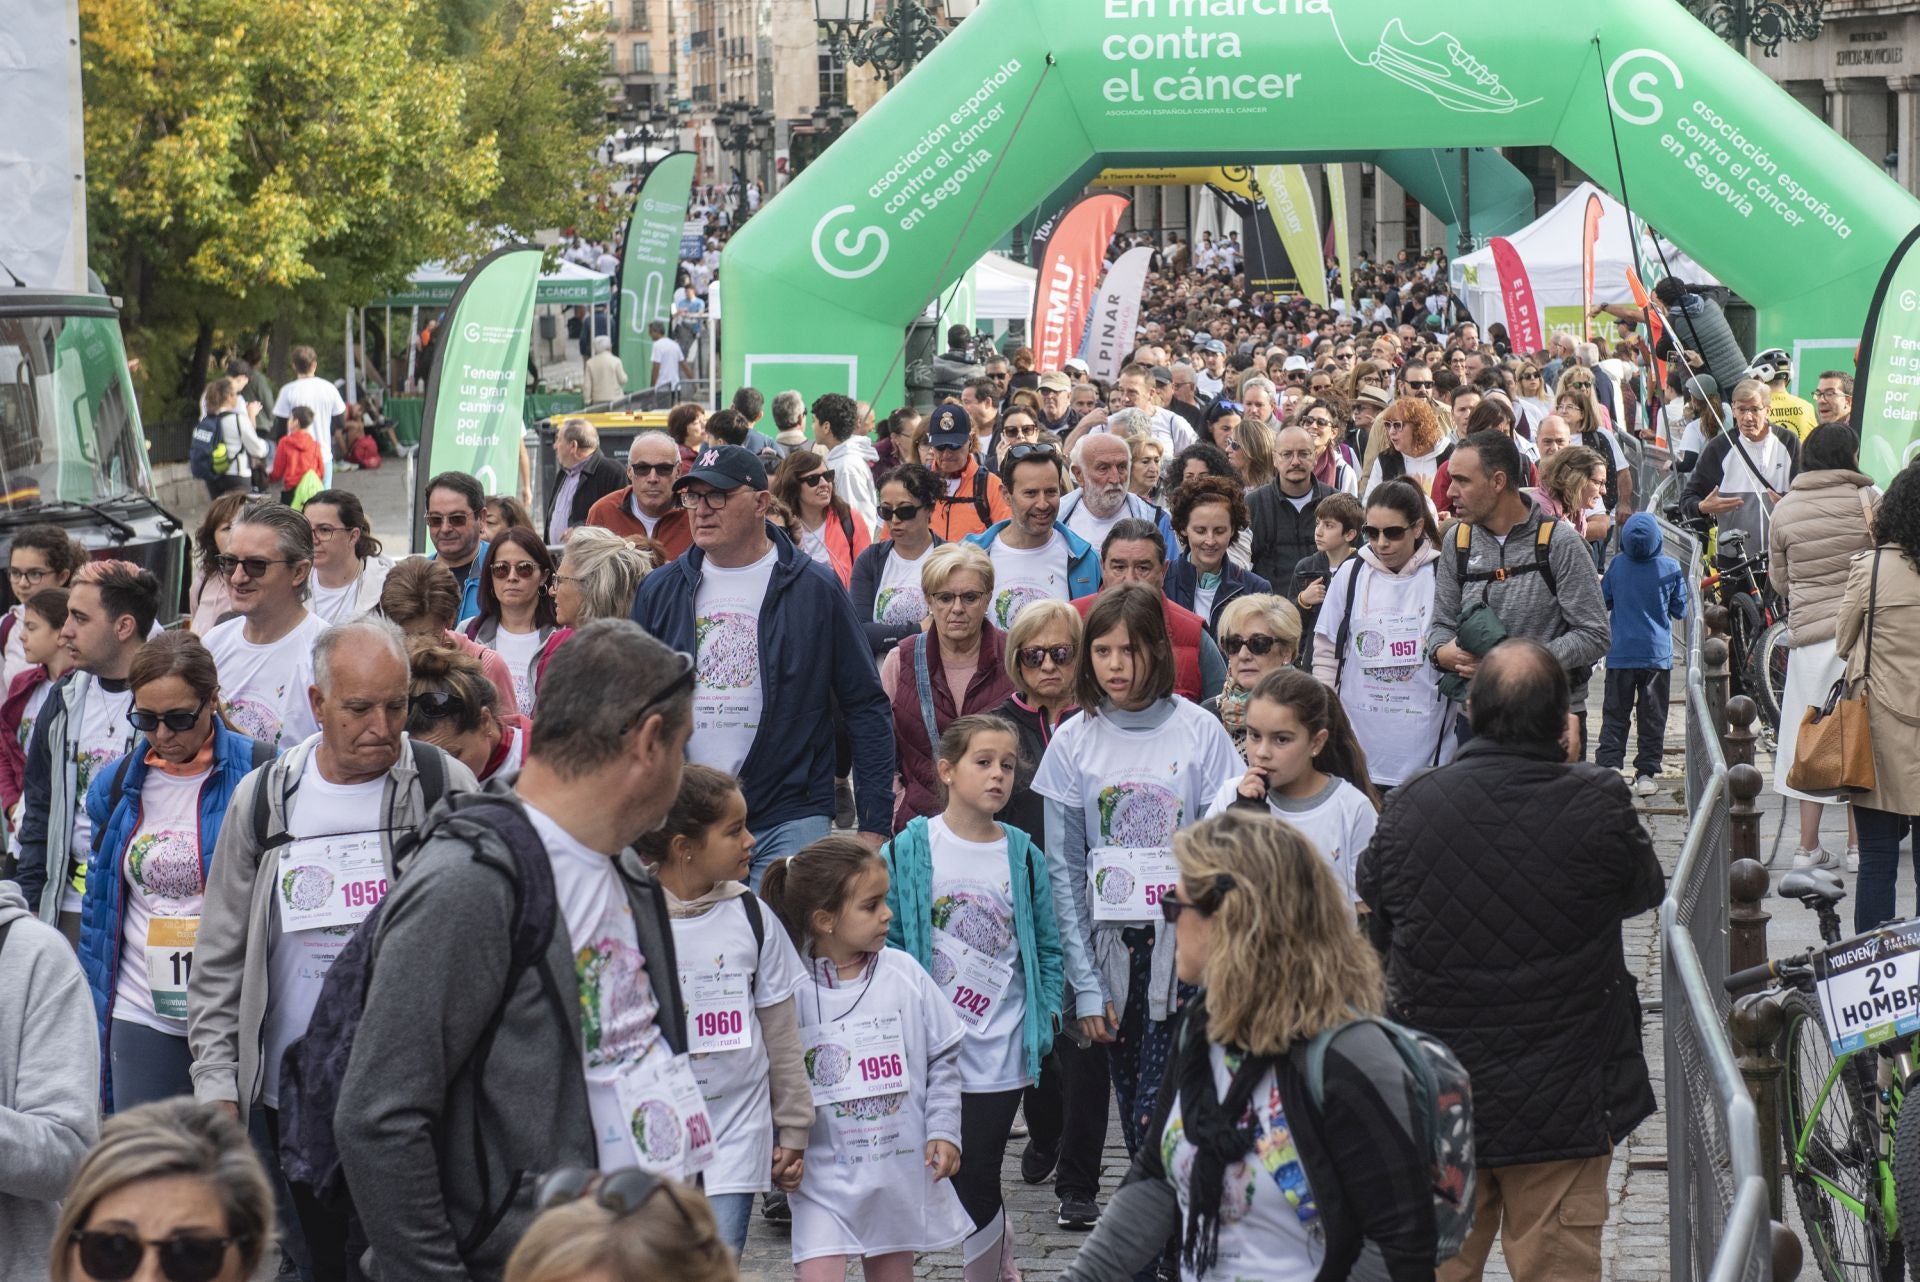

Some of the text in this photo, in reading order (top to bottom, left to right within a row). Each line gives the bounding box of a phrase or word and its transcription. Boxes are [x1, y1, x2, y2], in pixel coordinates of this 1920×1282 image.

[1102, 25, 1242, 61] contra
[1102, 66, 1302, 102] el cáncer
[1105, 108, 1152, 116] ASOCIACIÓN
[1152, 108, 1192, 116] ESPAÑOLA
[1236, 106, 1268, 114] CÁNCER
[868, 58, 1022, 198] asociación española
[884, 101, 1006, 214] contra el cáncer
[1692, 100, 1852, 240] asociación española
[1660, 134, 1754, 218] en Segovia
[1676, 117, 1806, 227] contra el cáncer
[900, 148, 992, 230] en Segovia
[1513, 278, 1524, 300] EL
[1099, 294, 1121, 361] PINAR
[1890, 356, 1906, 368] un
[460, 385, 508, 399] un gran
[1885, 390, 1909, 404] por
[458, 402, 505, 414] camino
[456, 418, 480, 431] por
[1390, 640, 1416, 656] 1957
[341, 879, 388, 907] 1959
[952, 986, 990, 1018] 1242
[695, 1010, 742, 1037] 1960
[858, 1054, 902, 1082] 1956
